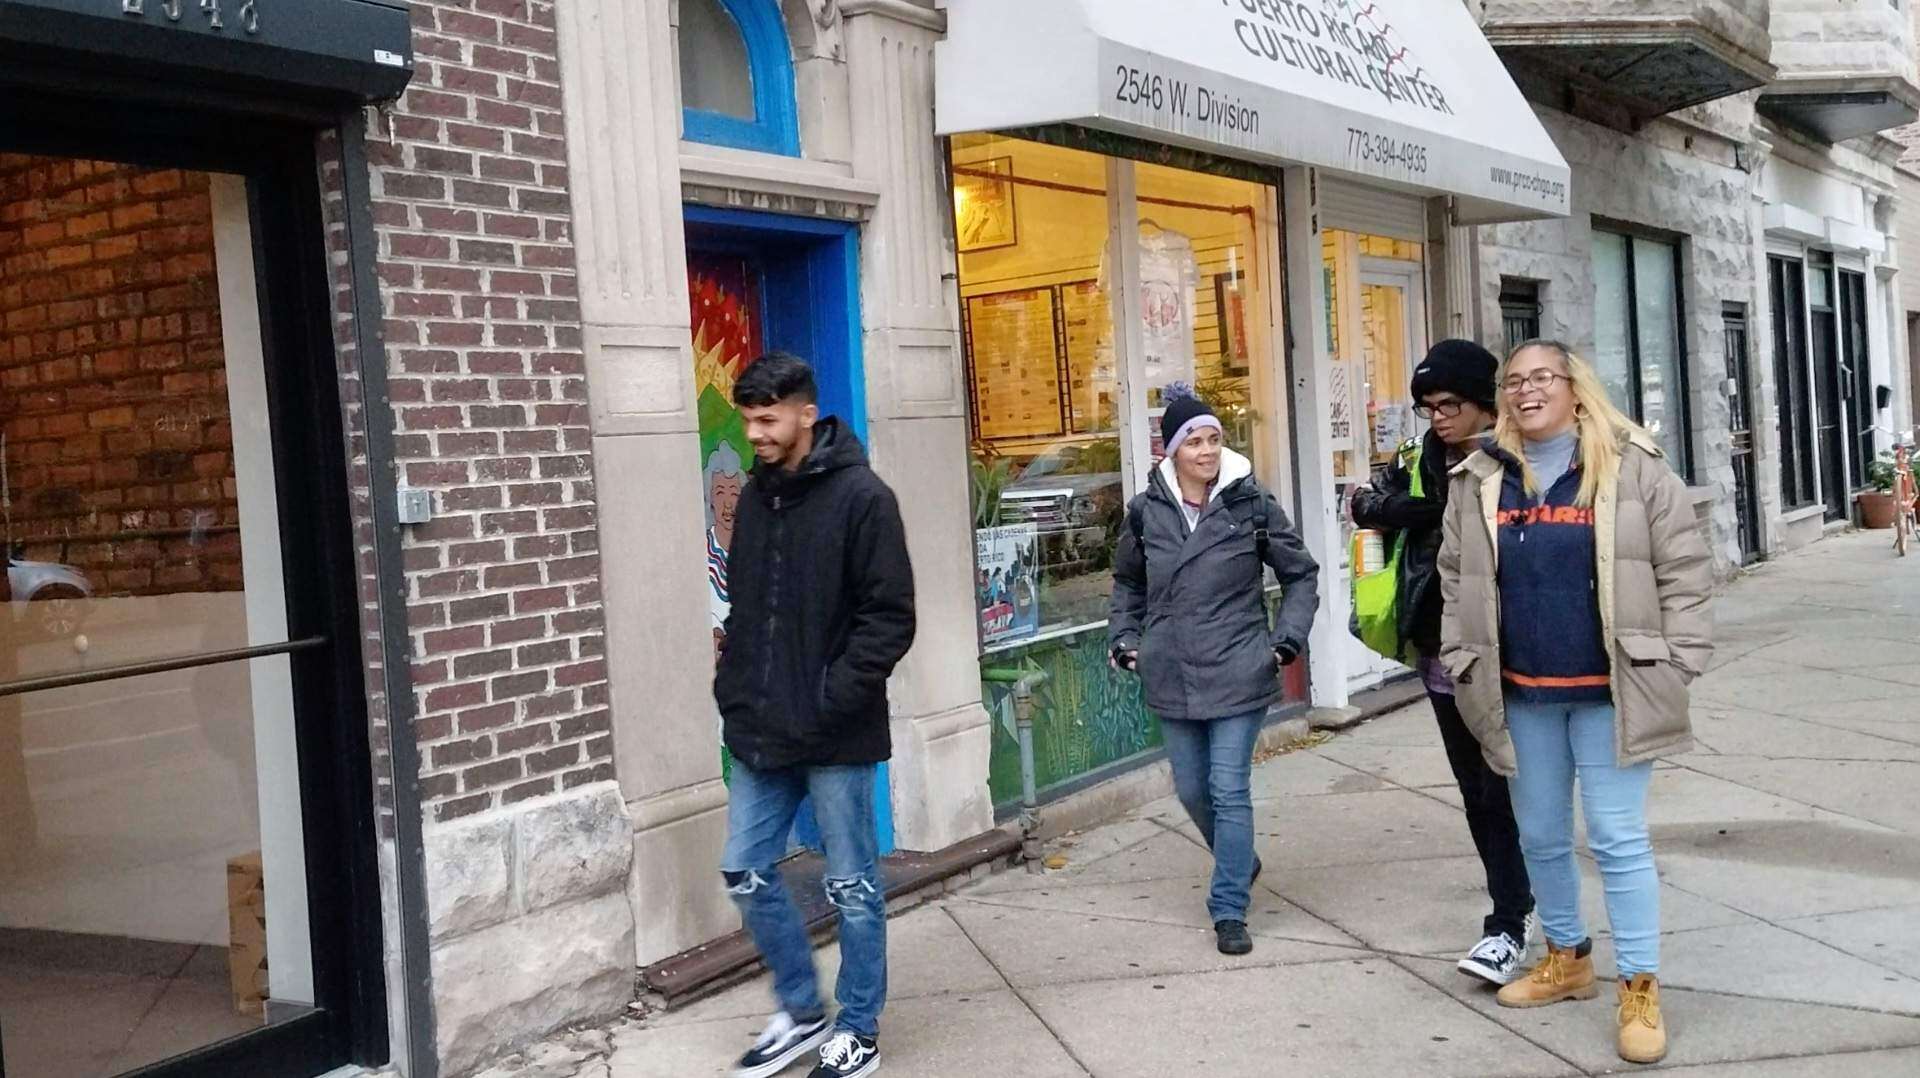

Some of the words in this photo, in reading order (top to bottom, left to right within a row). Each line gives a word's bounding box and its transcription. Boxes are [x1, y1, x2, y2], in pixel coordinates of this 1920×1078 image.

[1223, 0, 1320, 37] ERTO
[1235, 19, 1371, 90] CULTURAL
[1367, 64, 1454, 115] CENTER
[1116, 65, 1162, 110] 2546
[1169, 78, 1190, 118] W.
[1198, 87, 1259, 135] Division
[1348, 128, 1427, 173] 773-394-4935
